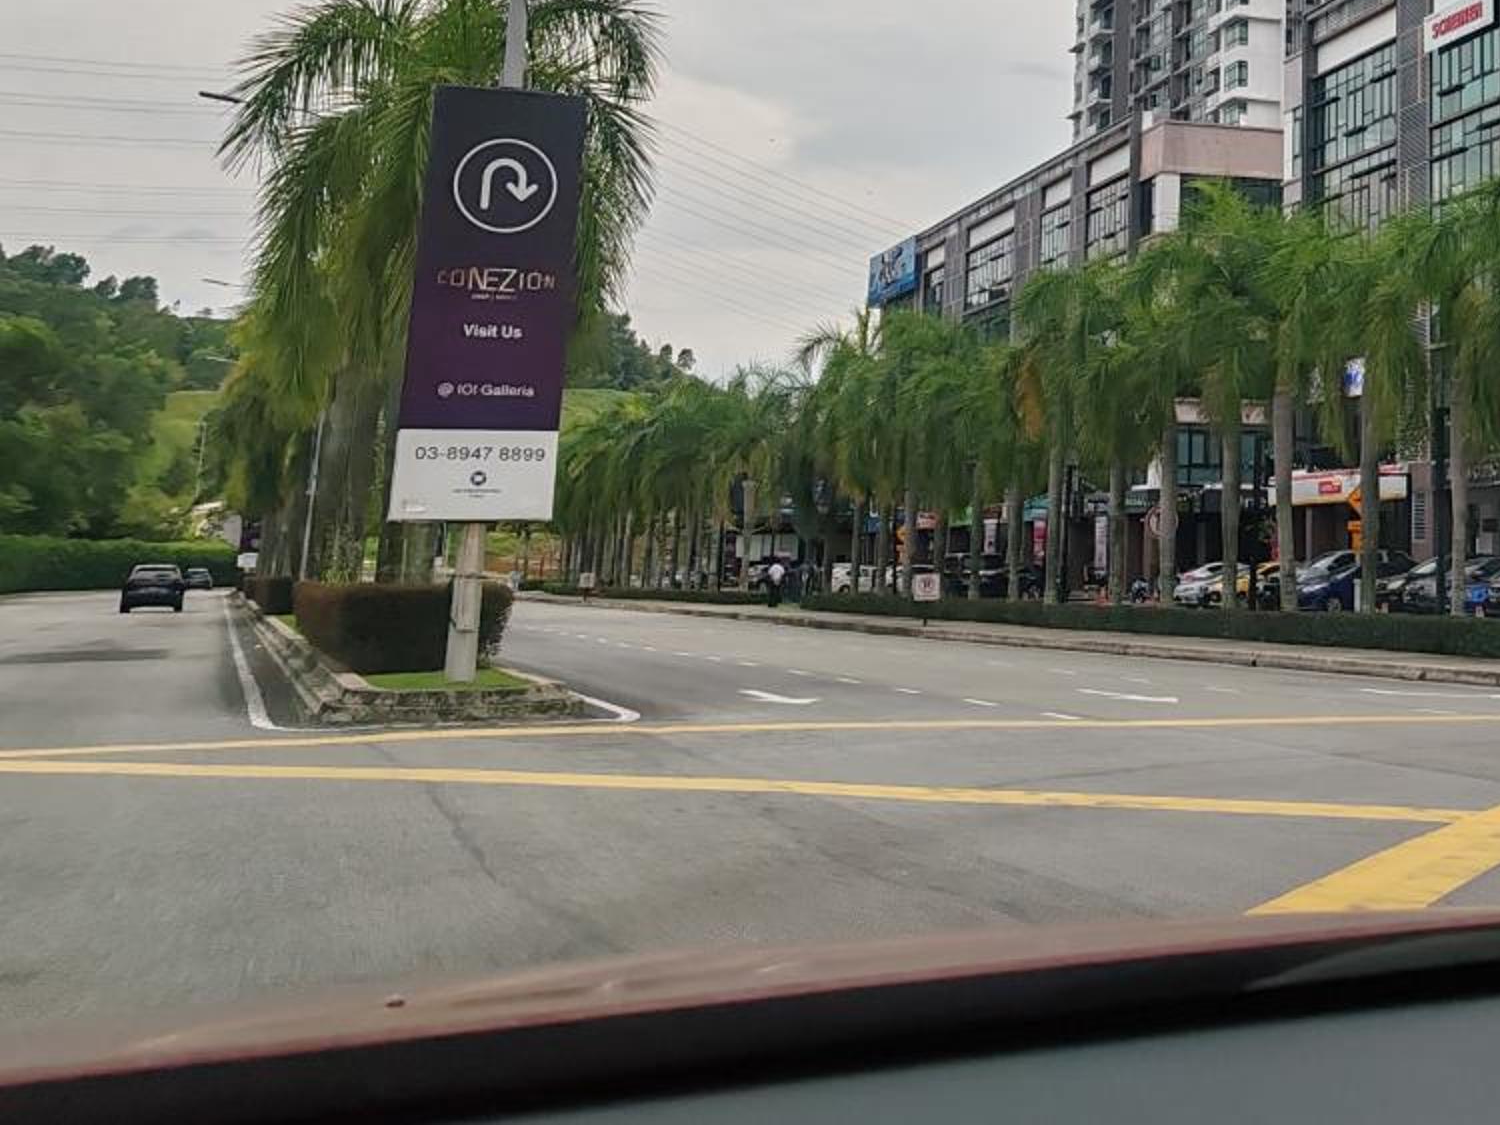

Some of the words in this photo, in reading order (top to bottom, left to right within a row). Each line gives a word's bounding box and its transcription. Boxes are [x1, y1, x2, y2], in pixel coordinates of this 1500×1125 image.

[463, 323, 498, 338] Visit
[501, 325, 523, 339] Us
[480, 384, 535, 397] Galleria
[415, 446, 493, 461] 03-8947
[499, 448, 546, 462] 8899
